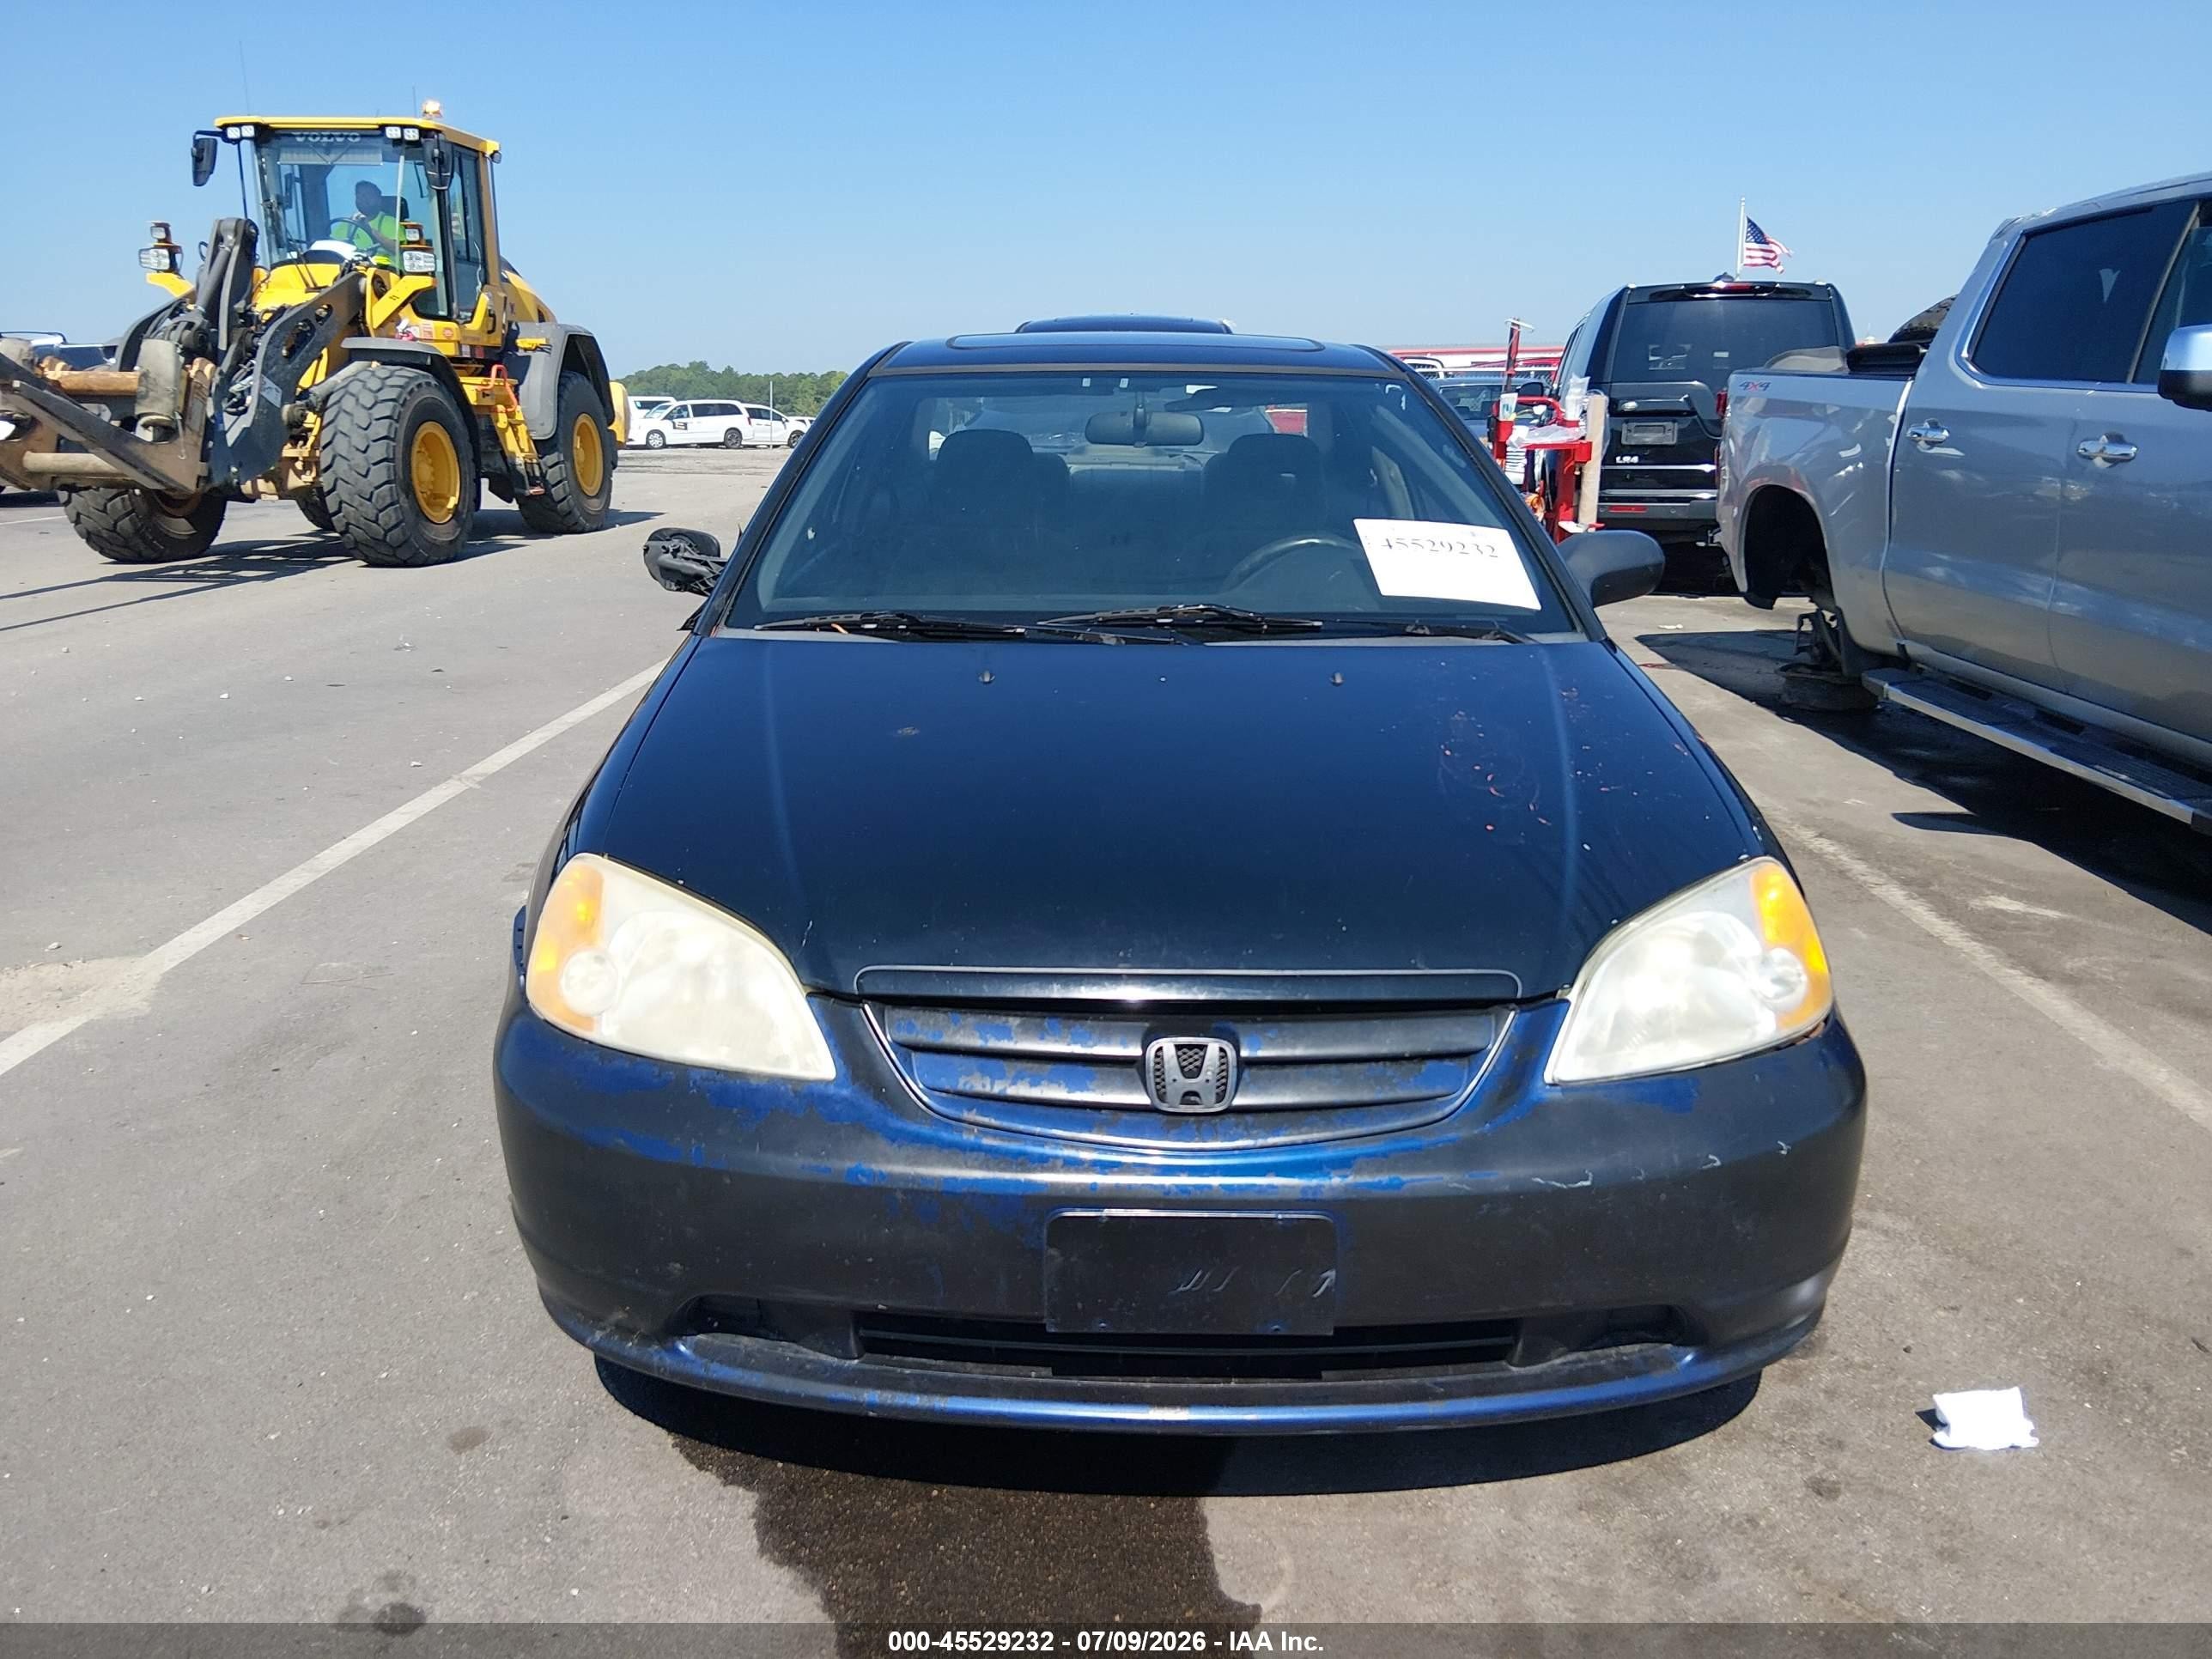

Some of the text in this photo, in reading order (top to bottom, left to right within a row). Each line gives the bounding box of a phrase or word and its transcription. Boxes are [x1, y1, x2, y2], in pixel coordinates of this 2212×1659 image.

[291, 131, 361, 143] VOLVO
[1615, 455, 1639, 464] LR4
[1381, 537, 1498, 558] 45529232
